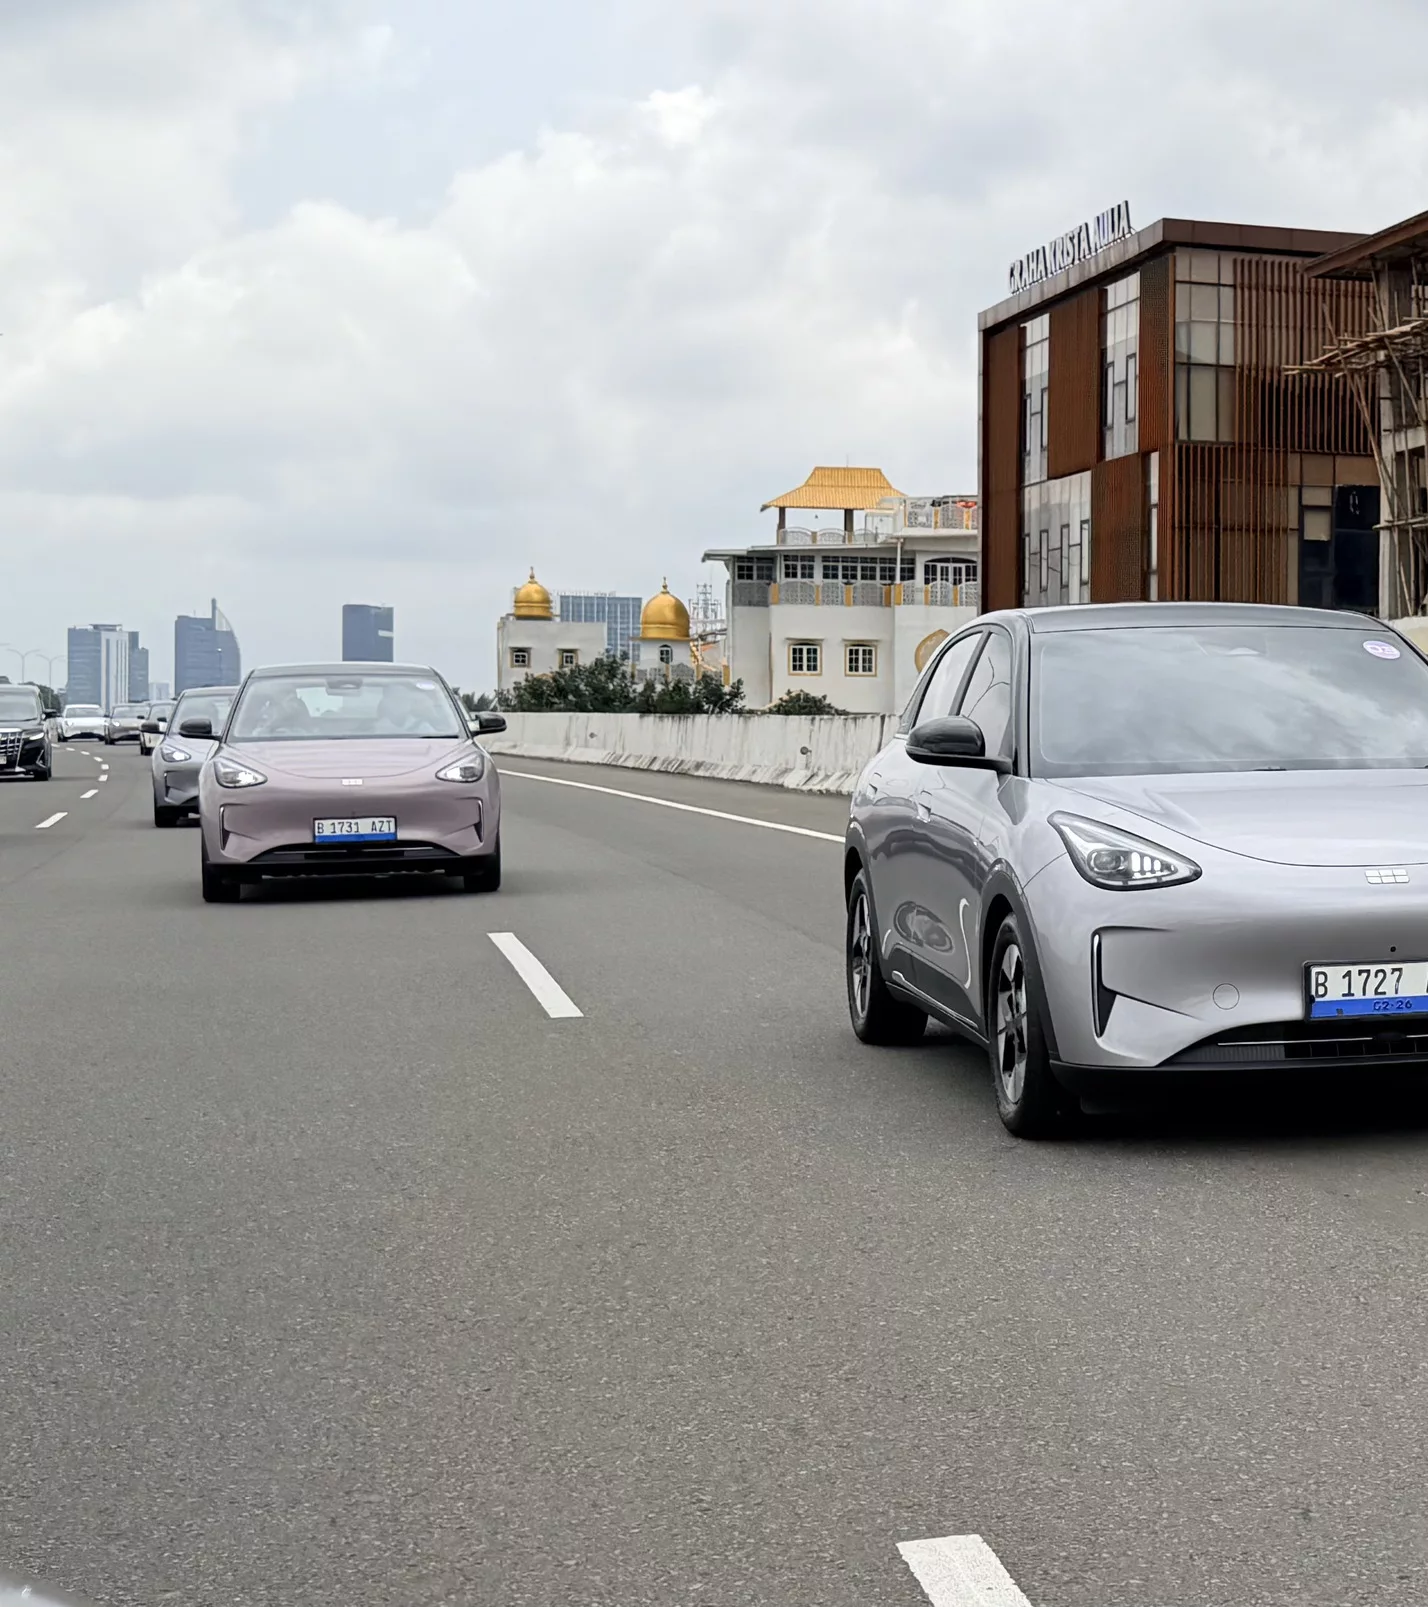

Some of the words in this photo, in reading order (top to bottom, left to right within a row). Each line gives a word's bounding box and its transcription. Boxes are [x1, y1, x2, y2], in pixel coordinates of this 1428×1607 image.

[1008, 245, 1048, 295] GRAHA
[1047, 222, 1092, 275] KRISTA
[1091, 199, 1133, 253] AULIA
[317, 822, 324, 834] B
[330, 821, 360, 834] 1731
[371, 820, 393, 832] AZT
[1314, 970, 1328, 999] B
[1341, 967, 1404, 998] 1727
